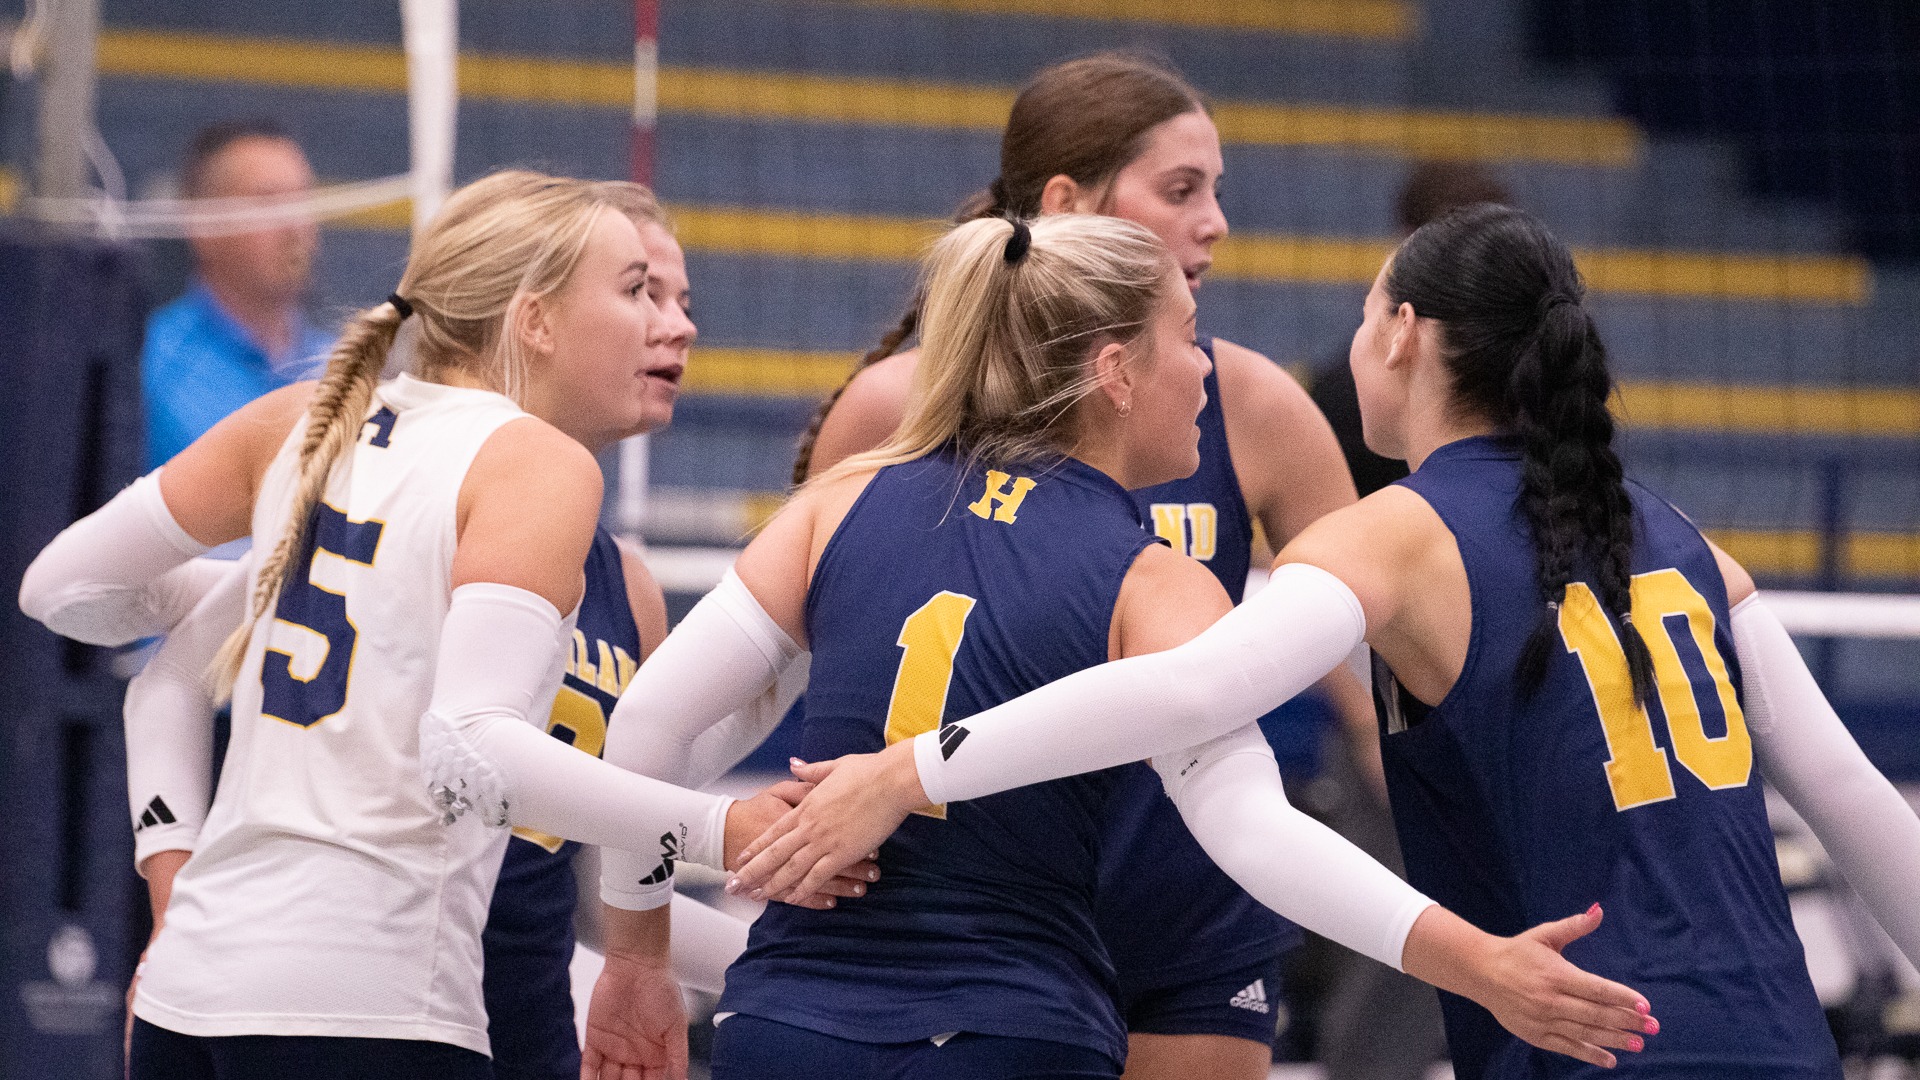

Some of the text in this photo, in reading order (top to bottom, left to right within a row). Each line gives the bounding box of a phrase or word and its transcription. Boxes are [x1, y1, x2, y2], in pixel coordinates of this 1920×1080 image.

[967, 469, 1037, 525] H
[260, 501, 386, 729] 5
[884, 589, 977, 820] 1
[1558, 567, 1753, 812] 10
[1230, 996, 1269, 1014] adidas
